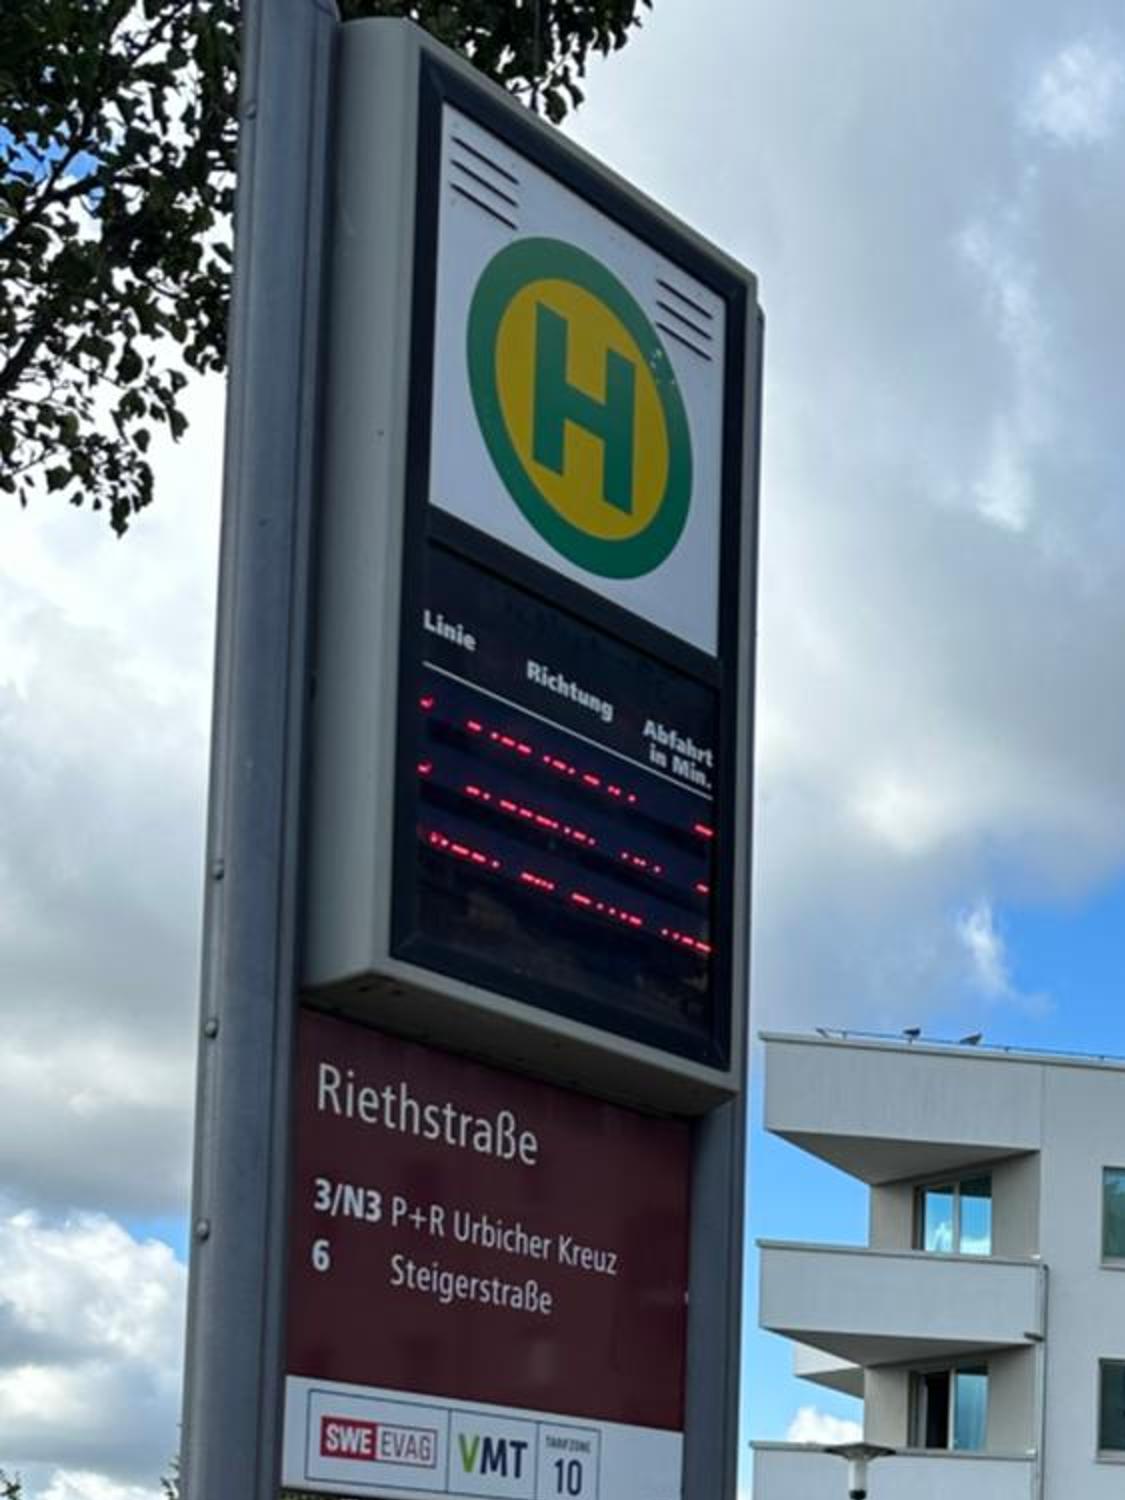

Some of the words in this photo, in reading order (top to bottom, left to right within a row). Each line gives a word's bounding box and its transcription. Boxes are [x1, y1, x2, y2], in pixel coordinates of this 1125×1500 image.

[532, 301, 636, 515] H
[422, 609, 477, 652] Linie
[526, 659, 615, 723] Richtung
[643, 719, 713, 768] Abfahrt
[649, 742, 667, 769] in
[672, 755, 712, 790] Min.
[317, 1062, 539, 1166] Riethstraße
[313, 1178, 382, 1222] 3/N3
[391, 1196, 445, 1237] P+R
[453, 1211, 552, 1260] Urbicher
[557, 1236, 618, 1276] Kreuz
[311, 1239, 331, 1273] 6
[390, 1254, 553, 1315] Steigerstraße
[324, 1422, 373, 1456] SWE
[381, 1424, 432, 1463] EVAG
[458, 1433, 529, 1479] VMT
[554, 1457, 583, 1497] 10
